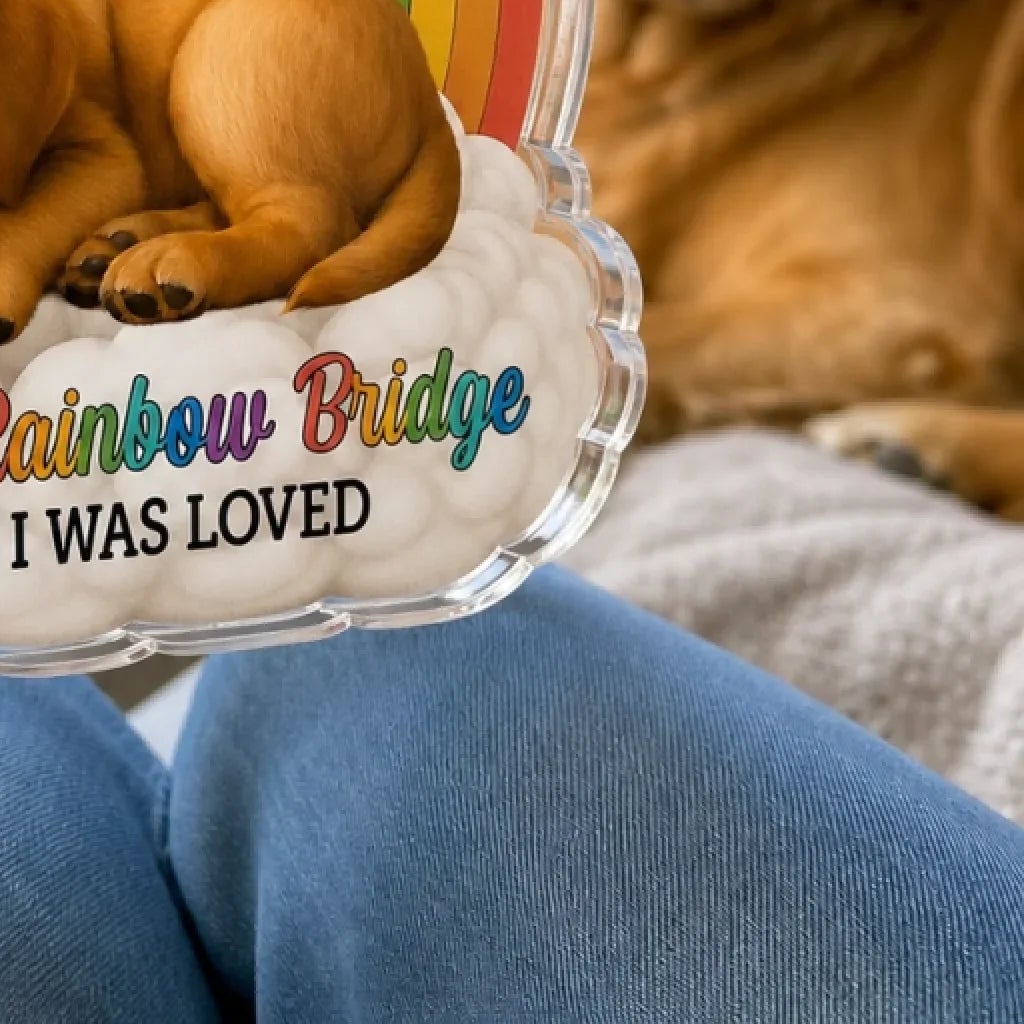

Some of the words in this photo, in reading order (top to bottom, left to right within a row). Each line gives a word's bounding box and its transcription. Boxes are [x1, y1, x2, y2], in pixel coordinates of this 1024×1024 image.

[293, 347, 531, 471] Bridge
[11, 511, 29, 569] I
[45, 497, 169, 565] WAS
[187, 479, 371, 551] LOVED
